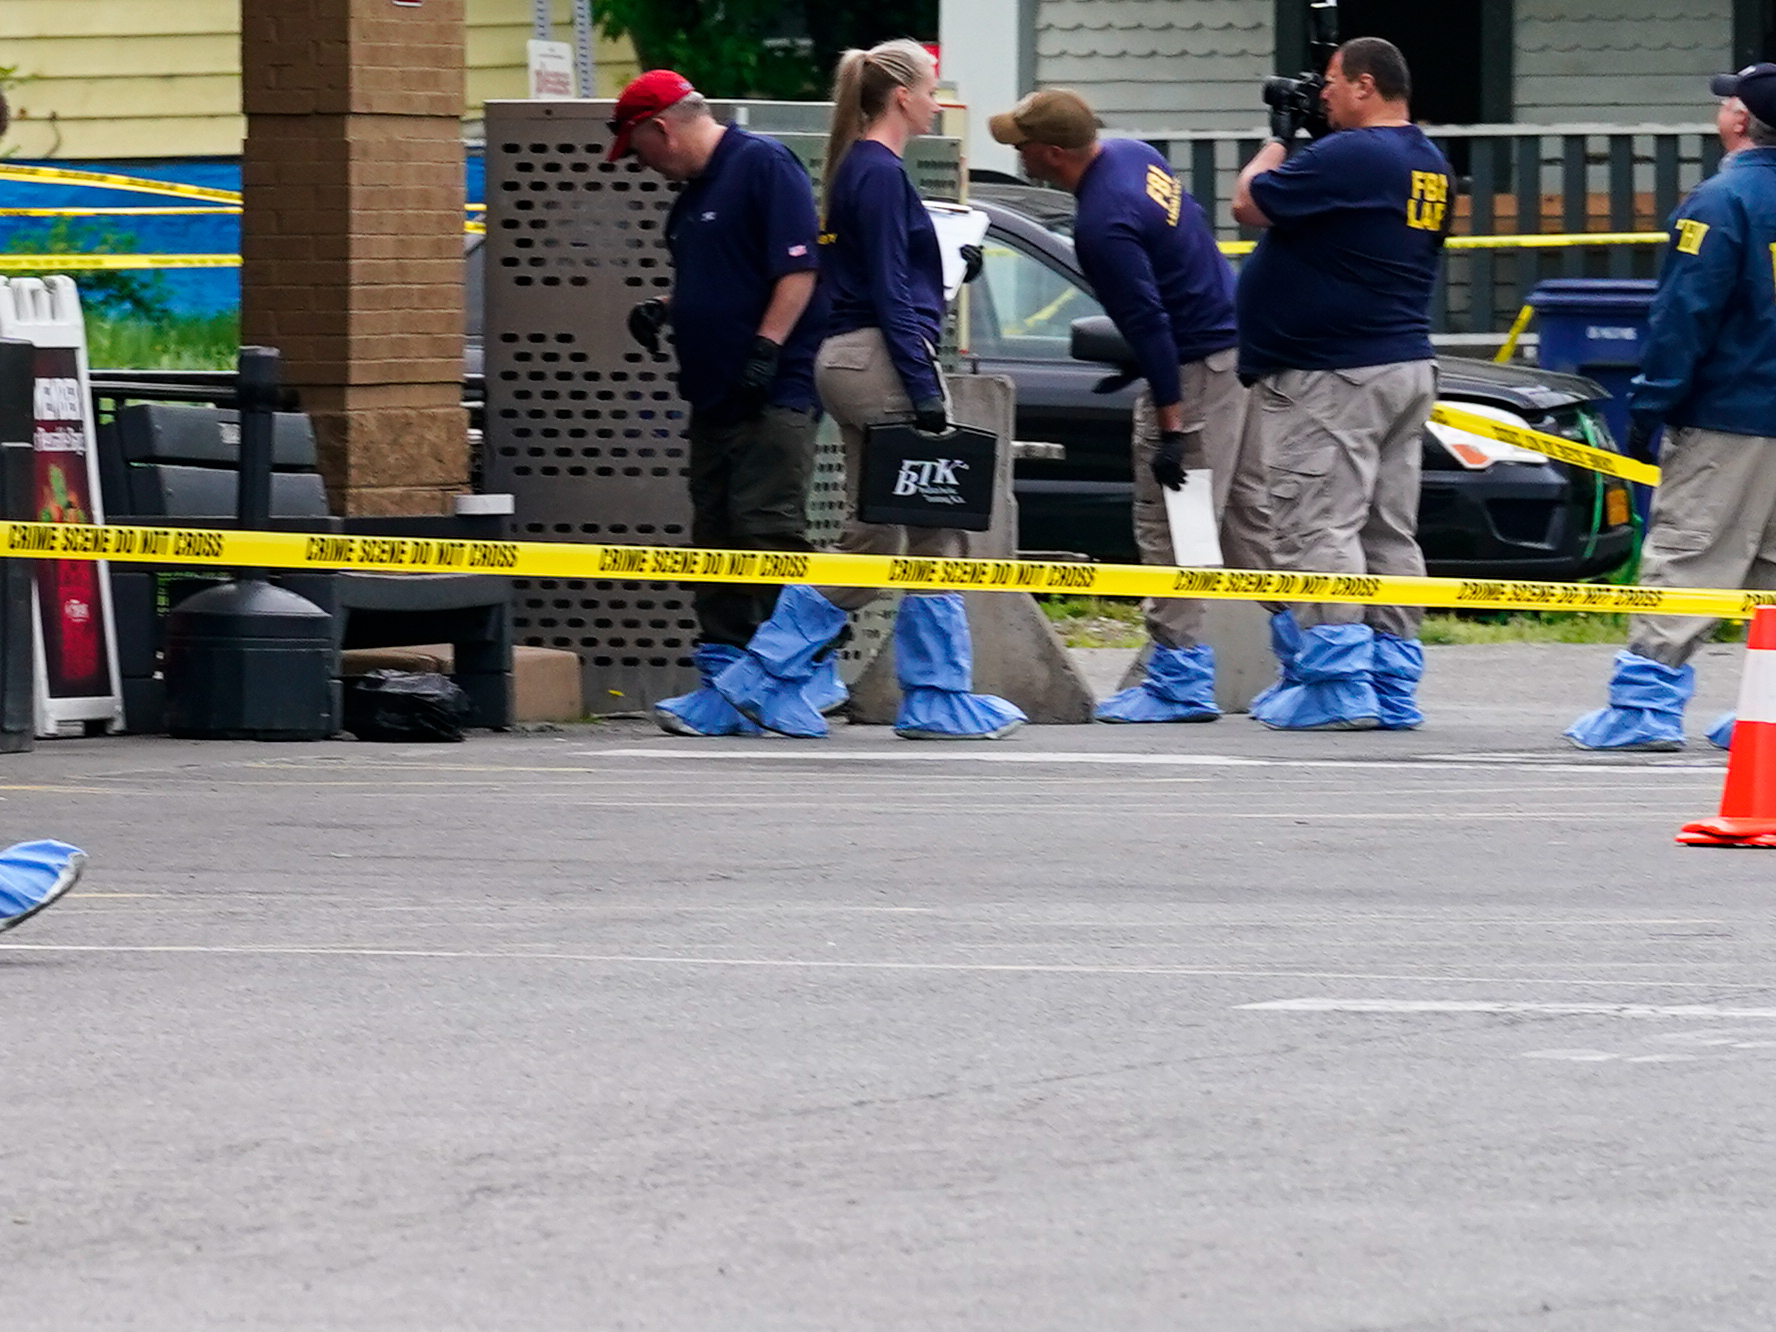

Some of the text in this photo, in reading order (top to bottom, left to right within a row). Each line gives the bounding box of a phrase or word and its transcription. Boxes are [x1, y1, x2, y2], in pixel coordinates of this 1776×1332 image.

[1146, 164, 1175, 216] FBI
[1411, 170, 1449, 202] FBI
[8, 523, 225, 558] CRIME SCENE DO NOT CROSS
[305, 536, 519, 569] CRIME SCENE DO NOT CROSS
[598, 547, 811, 579] CRIME SCENE DO NOT CROSS
[888, 558, 1098, 588] CRIME SCENE DO NOT CROSS
[1173, 568, 1382, 598] CRIME SCENE DO NOT CROSS
[1457, 580, 1665, 609] CRIME SCENE DO NOT CROSS
